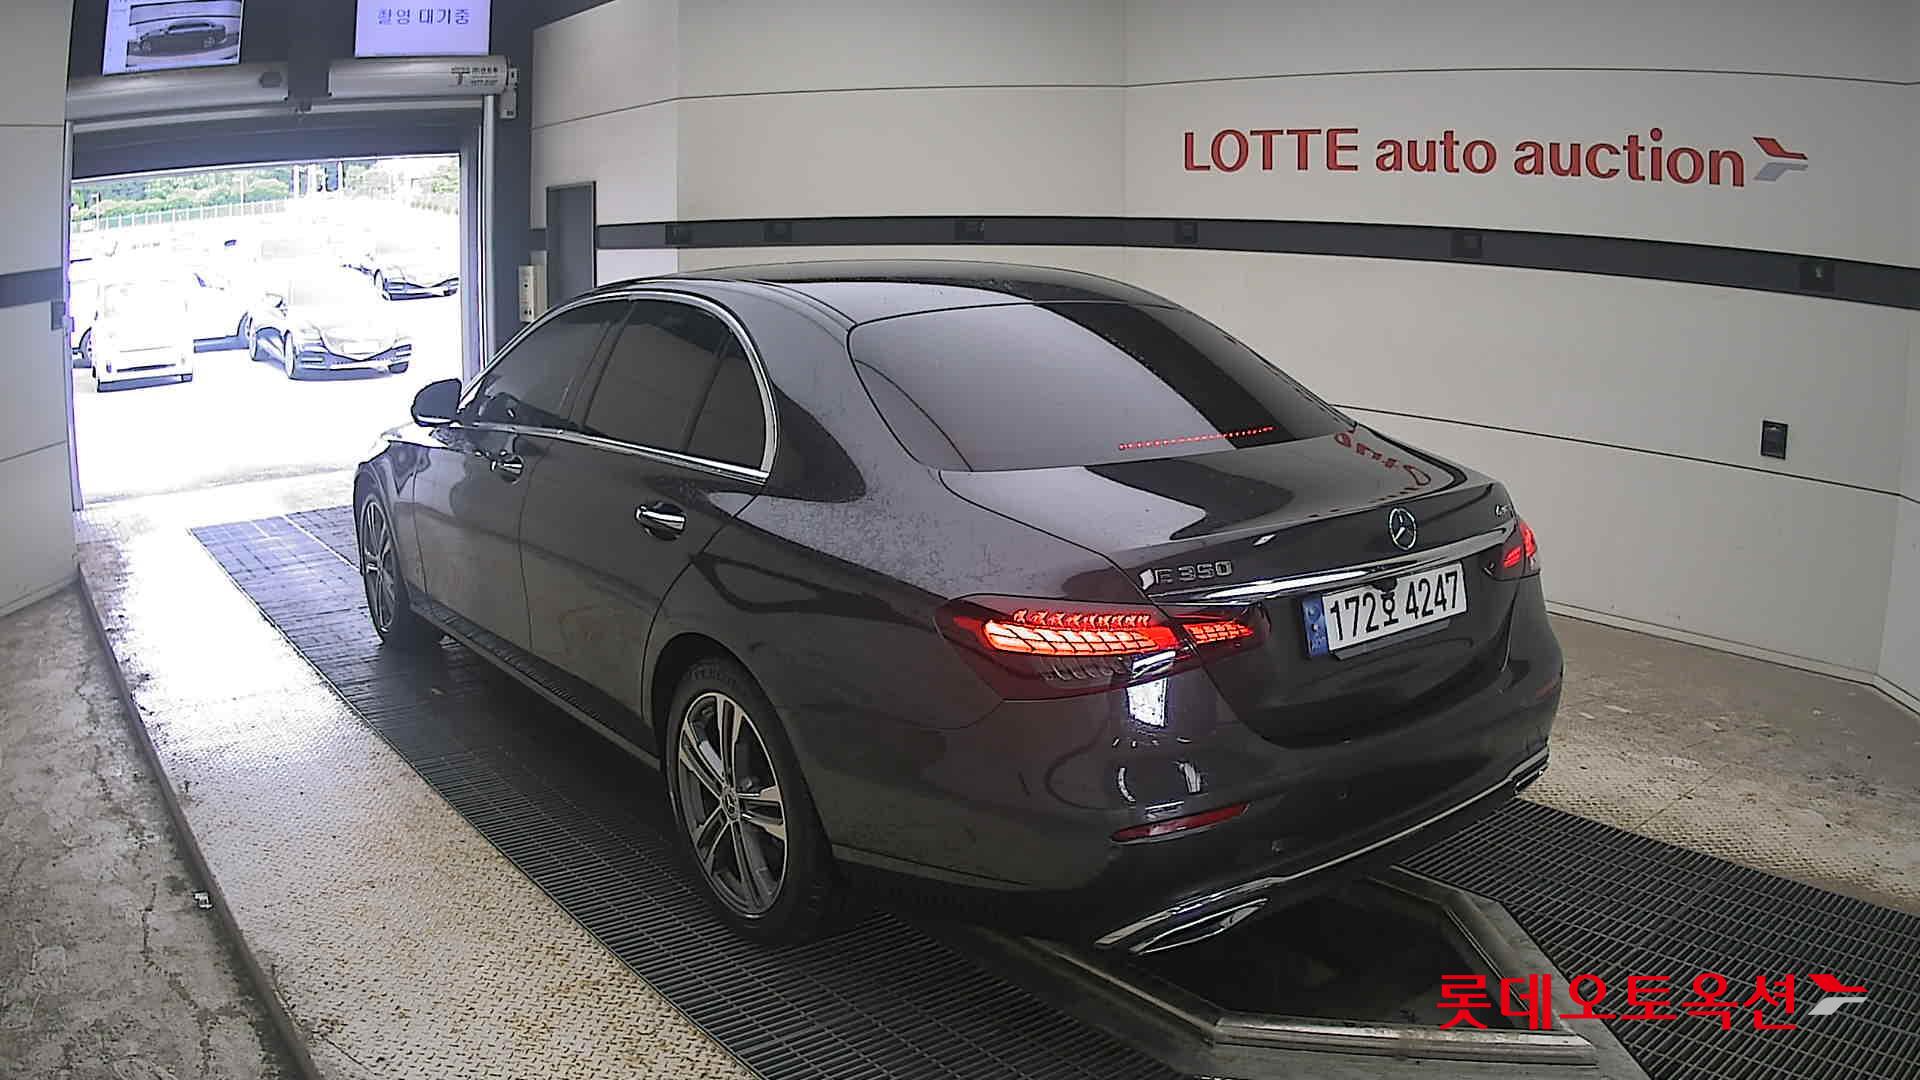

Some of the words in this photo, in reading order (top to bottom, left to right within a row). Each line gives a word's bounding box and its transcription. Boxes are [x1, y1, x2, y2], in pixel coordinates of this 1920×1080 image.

[419, 8, 470, 25] 대기중
[1184, 128, 1359, 173] LOTTE
[1375, 130, 1497, 174] auto
[1513, 127, 1745, 188] auction
[1178, 560, 1233, 583] 350
[1405, 570, 1458, 620] 4247
